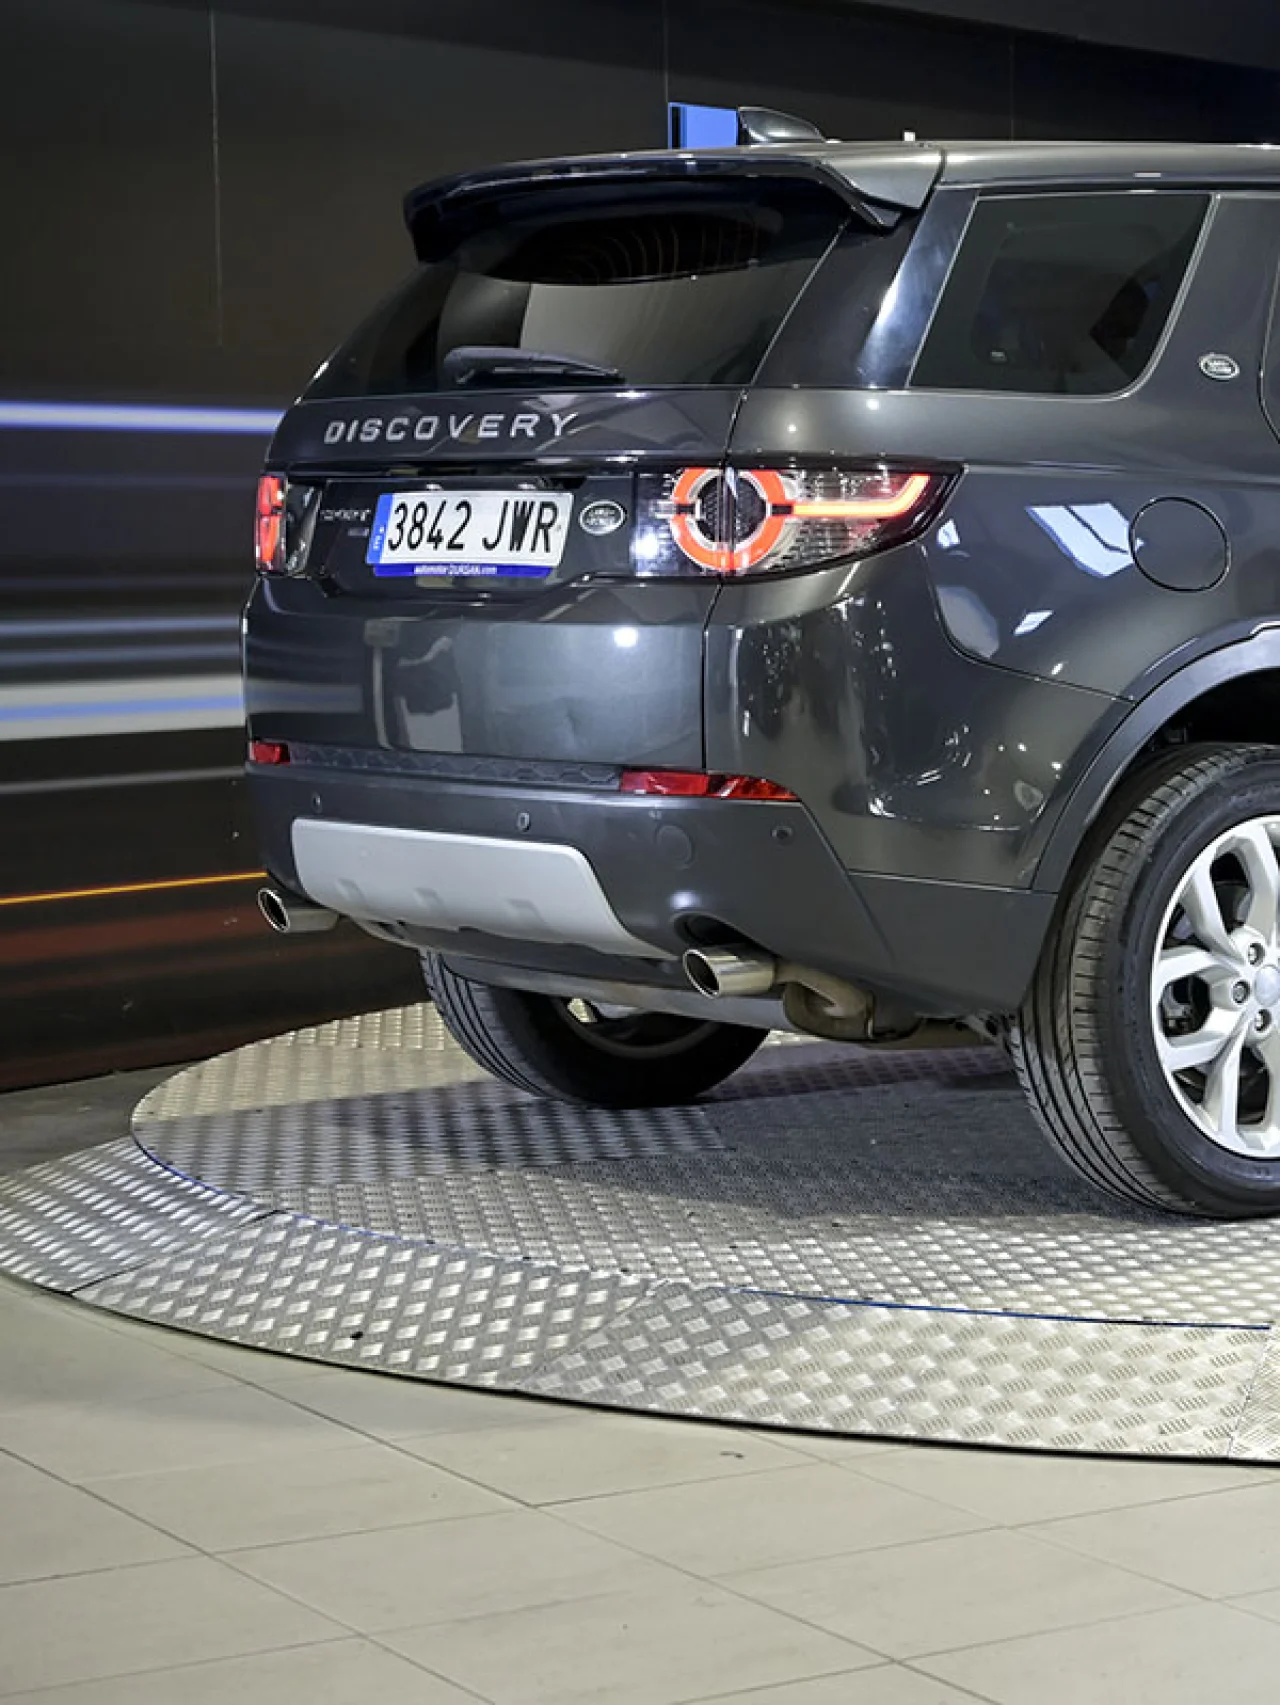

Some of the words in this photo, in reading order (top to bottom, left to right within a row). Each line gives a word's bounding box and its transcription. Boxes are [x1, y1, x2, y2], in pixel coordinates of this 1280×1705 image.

[323, 412, 579, 444] DISCOVERY
[387, 499, 473, 551] 3842
[482, 499, 559, 553] JWR
